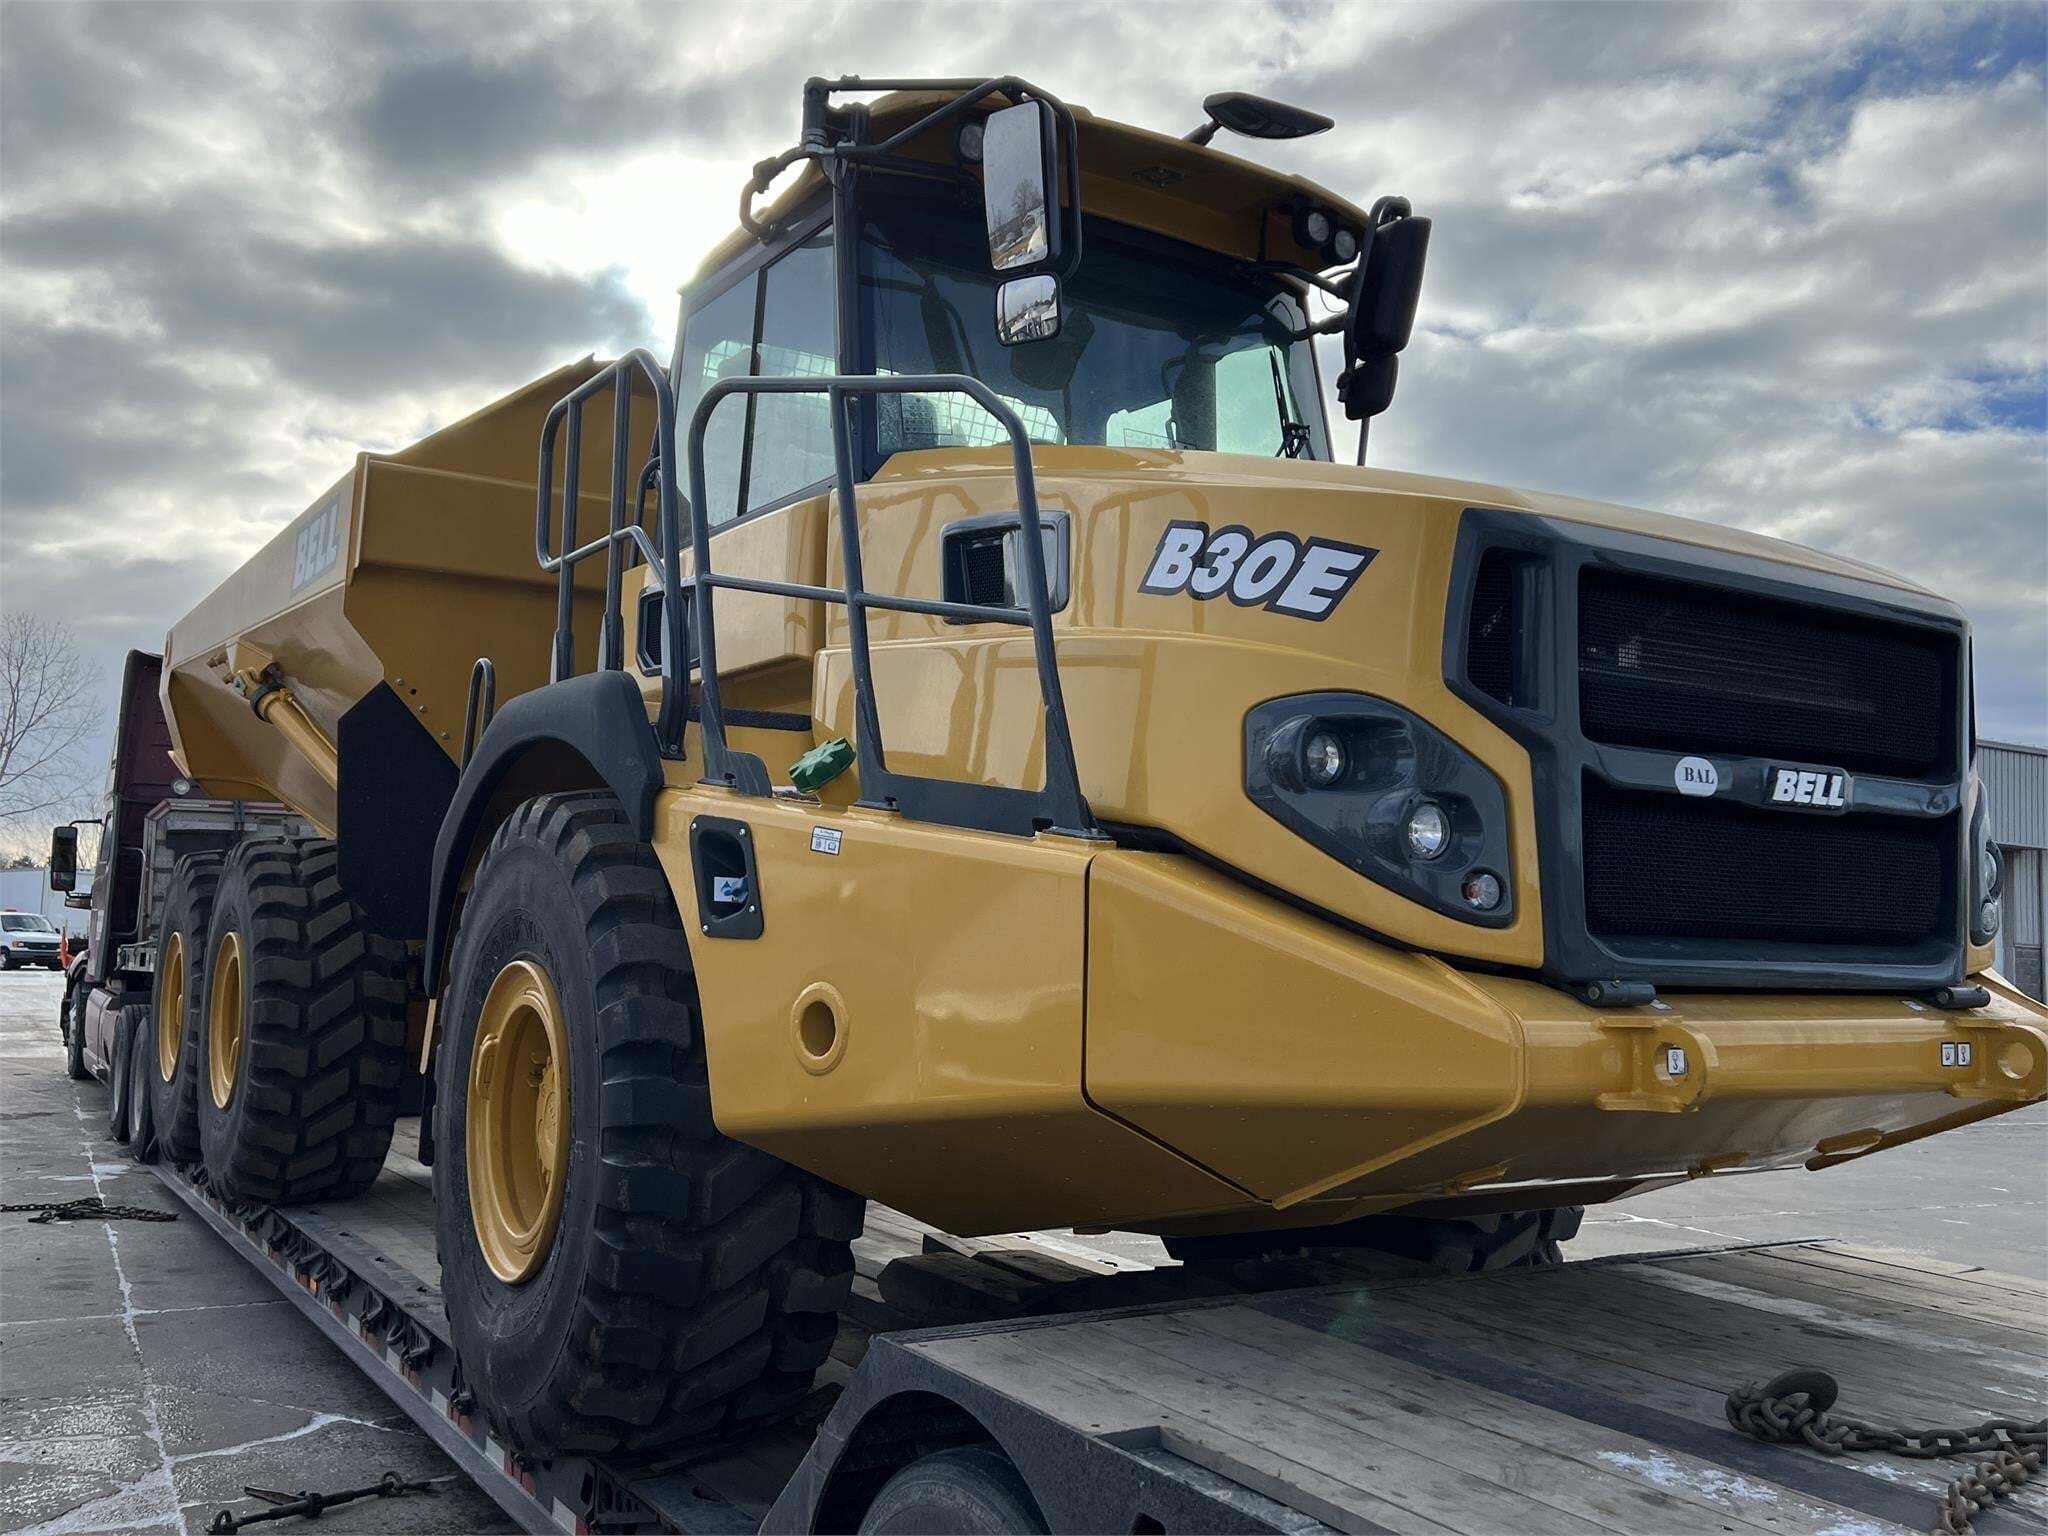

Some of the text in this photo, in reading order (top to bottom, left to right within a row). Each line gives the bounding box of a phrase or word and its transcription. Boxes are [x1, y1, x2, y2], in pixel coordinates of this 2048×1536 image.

[291, 502, 338, 591] BELL
[1140, 522, 1376, 619] B30E
[1684, 766, 1715, 785] BAL
[1772, 768, 1845, 807] BELL
